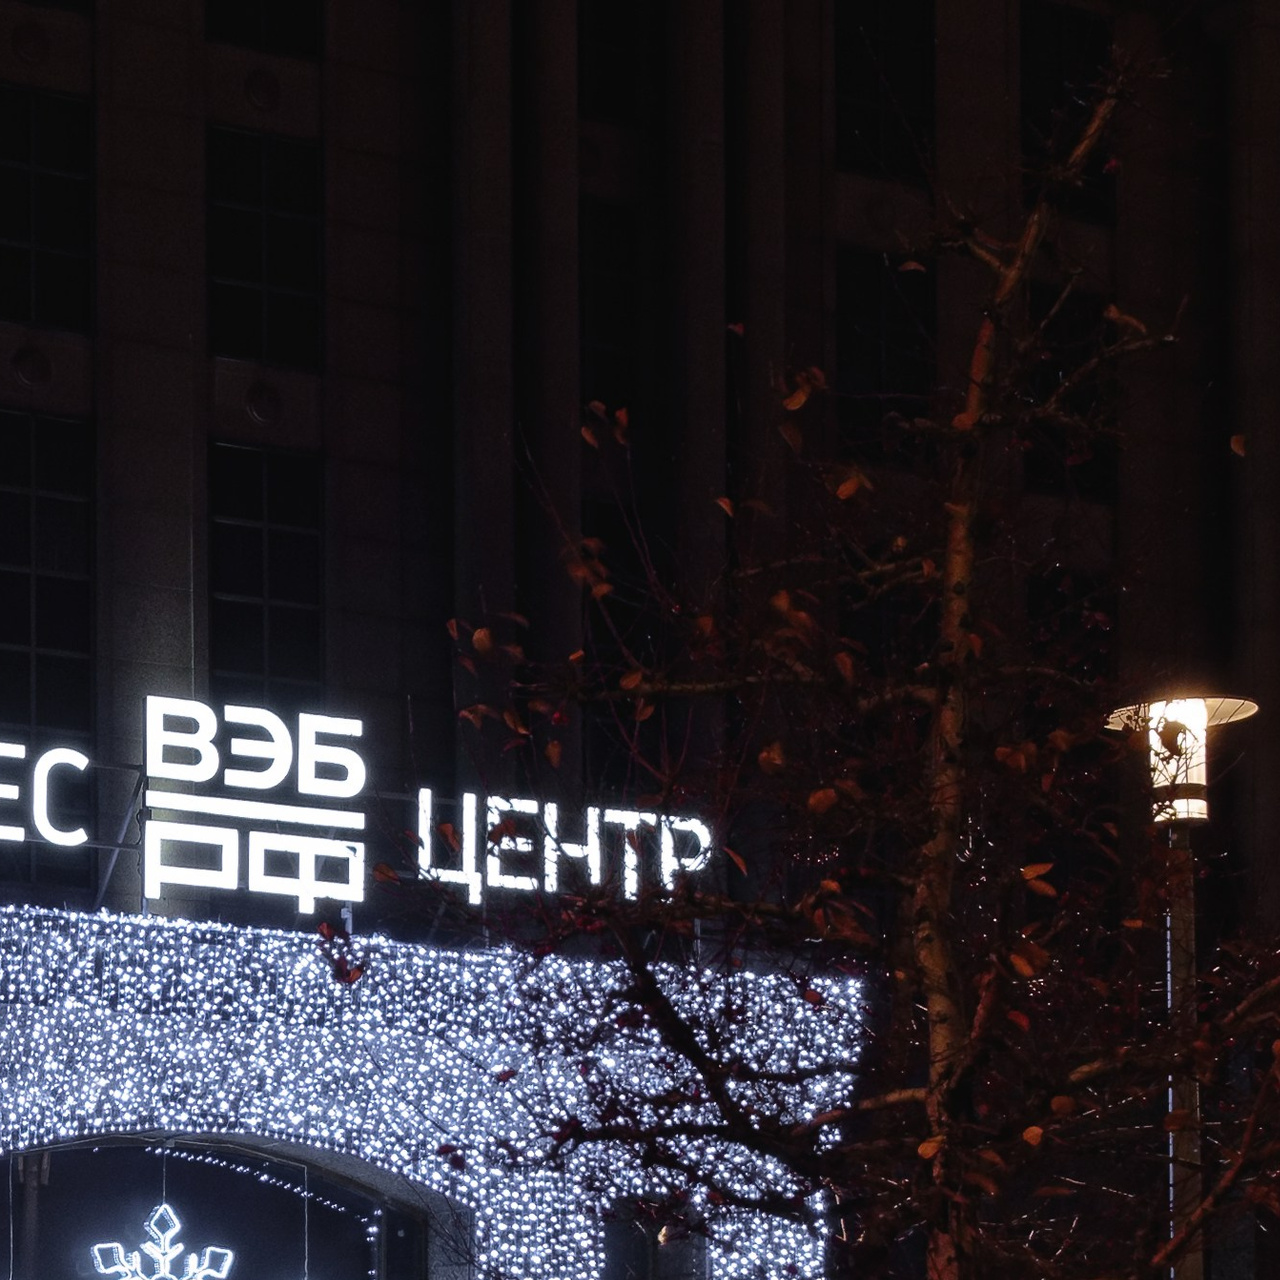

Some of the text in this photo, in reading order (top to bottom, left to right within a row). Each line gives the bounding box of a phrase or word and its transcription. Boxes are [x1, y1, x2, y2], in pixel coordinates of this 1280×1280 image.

[145, 695, 367, 798] ВЭБ
[143, 820, 366, 914] РФ
[417, 787, 713, 905] ЦЕНТР
